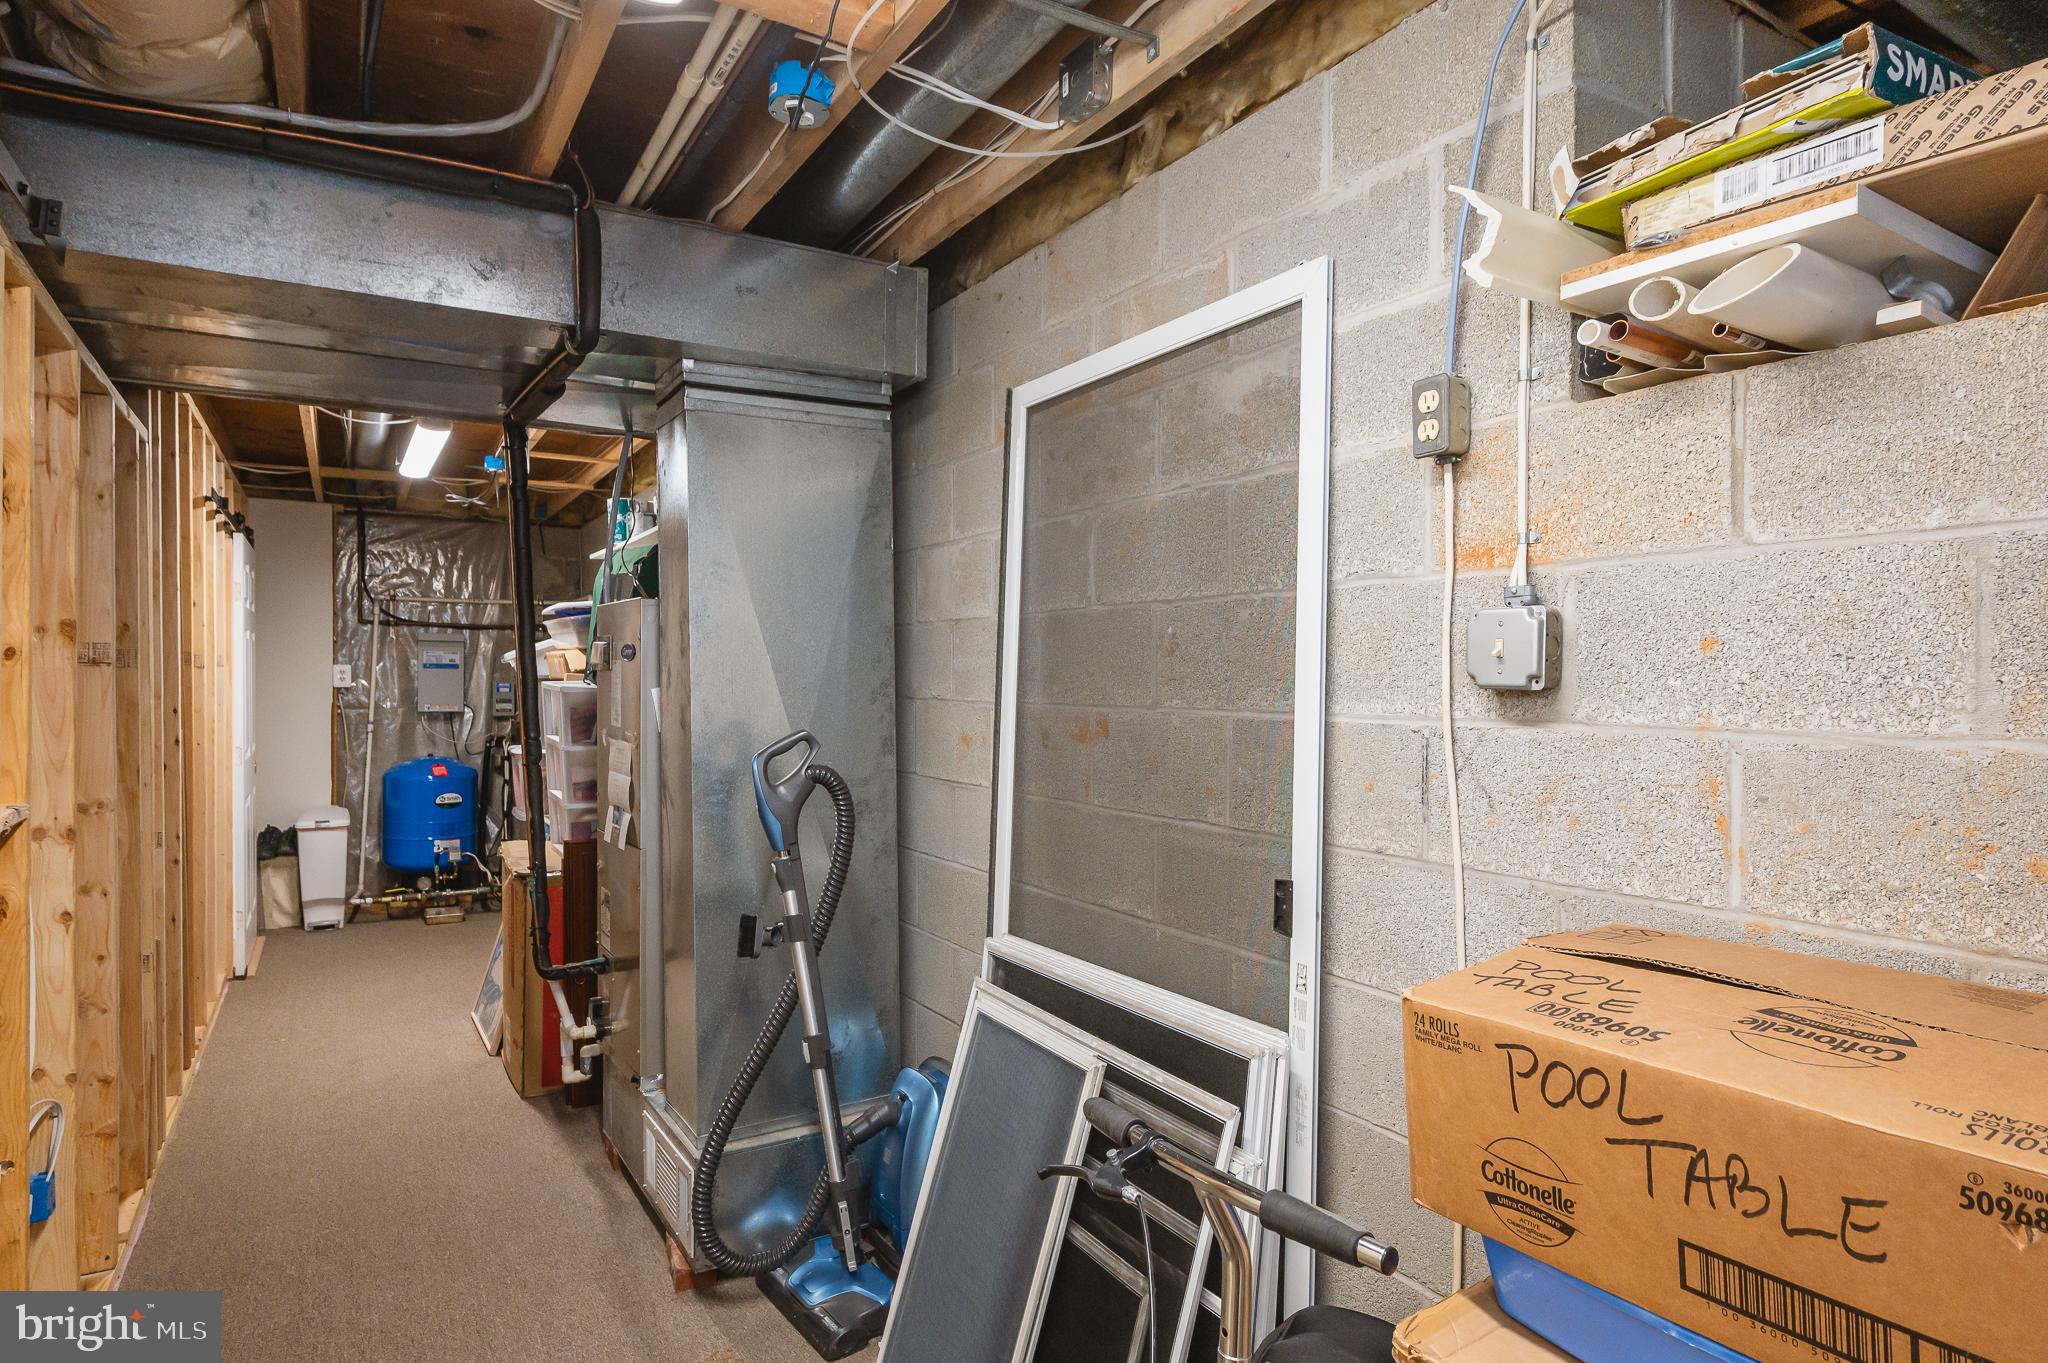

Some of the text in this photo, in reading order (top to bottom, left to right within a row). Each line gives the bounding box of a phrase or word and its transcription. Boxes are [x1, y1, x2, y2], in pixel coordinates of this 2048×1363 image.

[1887, 44, 1974, 96] SMAR
[1973, 77, 2038, 141] Genesis
[1473, 973, 1639, 1013] TABLE
[1503, 960, 1641, 994] POOL
[1414, 1012, 1459, 1038] 24 ROLLS
[1415, 1027, 1483, 1053] FAMILY MEGA ROLL
[1415, 1034, 1462, 1054] WHITE/BLANC
[1553, 1021, 1604, 1037] 36000
[1737, 1016, 1906, 1062] Cottonelle
[1495, 1043, 1664, 1125] POOL
[1911, 1100, 2034, 1136] MEGA ROLL
[1481, 1160, 1575, 1214] Cottonelle
[1604, 1137, 1888, 1263] TABLE
[2003, 1181, 2048, 1203] 3600
[1497, 1196, 1561, 1228] Ultra CleanCare
[1721, 1307, 1739, 1322] 00
[1750, 1321, 1799, 1348] 36000
